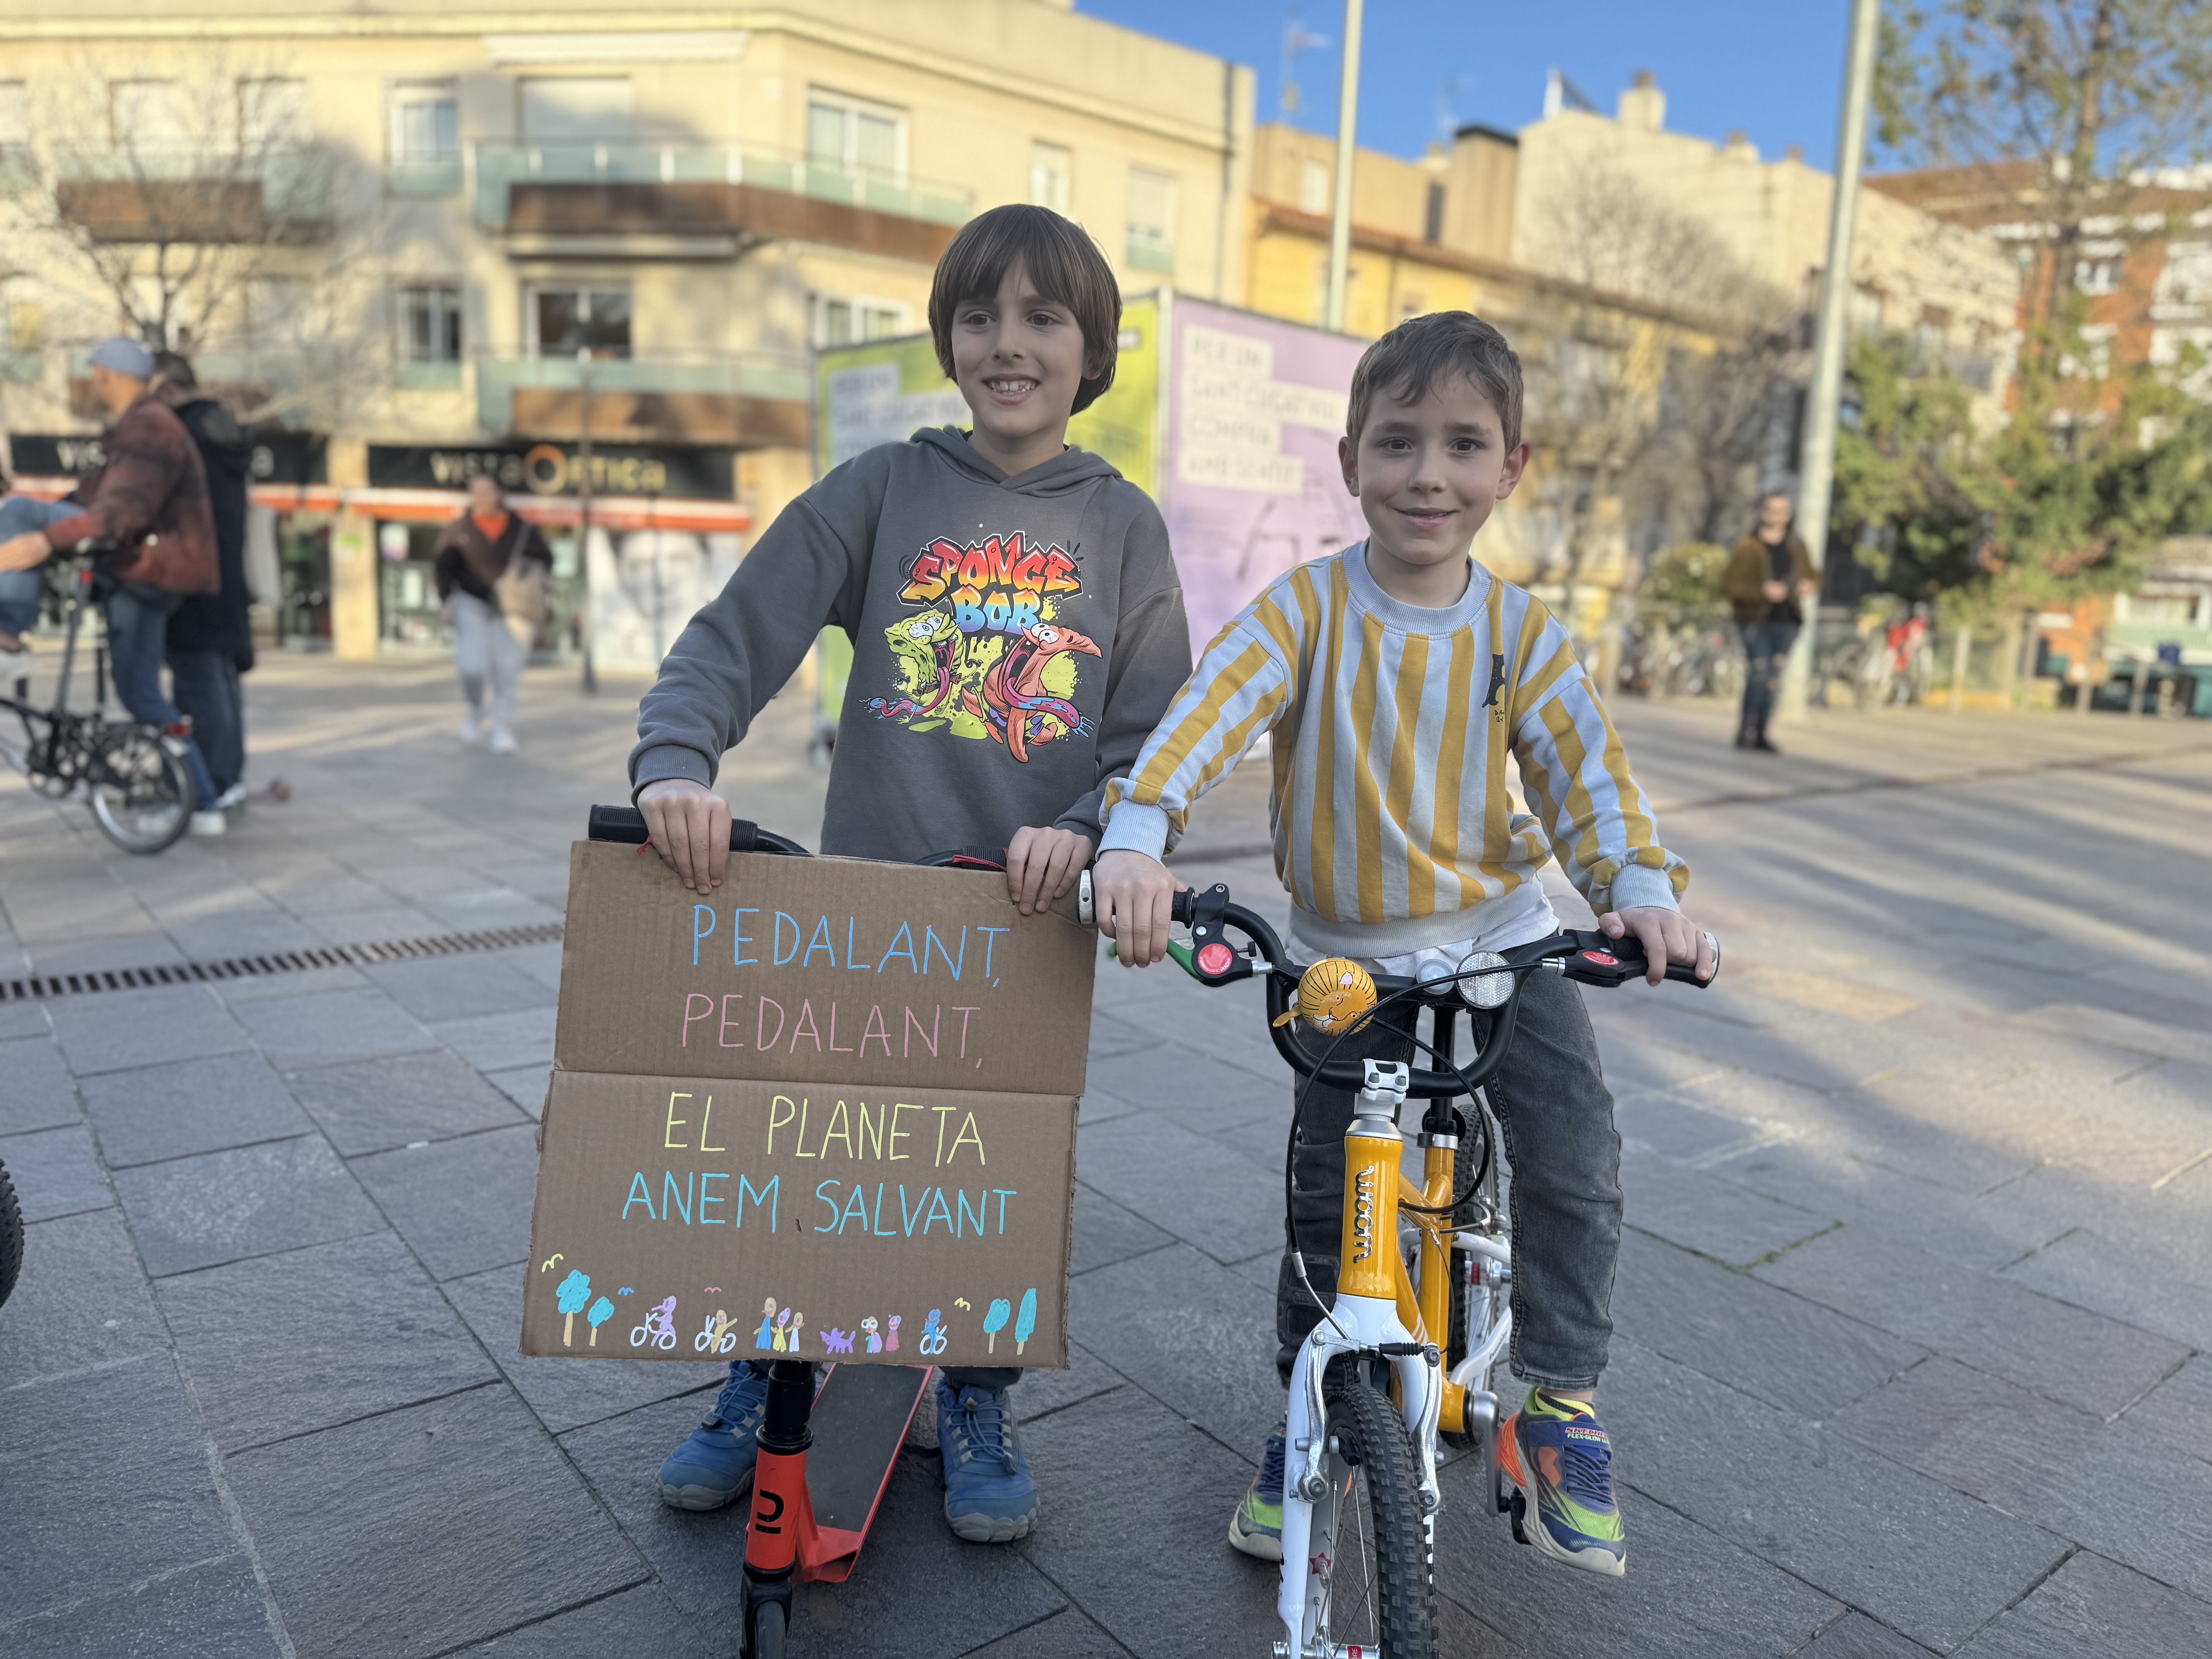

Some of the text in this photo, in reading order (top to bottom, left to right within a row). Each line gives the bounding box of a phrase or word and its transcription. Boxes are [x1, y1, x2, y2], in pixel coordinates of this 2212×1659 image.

[902, 534, 1079, 601] SPONGE
[950, 586, 1041, 636] BOB
[693, 905, 1009, 987] PEDALANT,
[682, 994, 983, 1069] PEDALANT,
[665, 1092, 986, 1166] EL PLANETA
[622, 1171, 1016, 1238] ANEM SALVANT
[1353, 1165, 1374, 1264] woom
